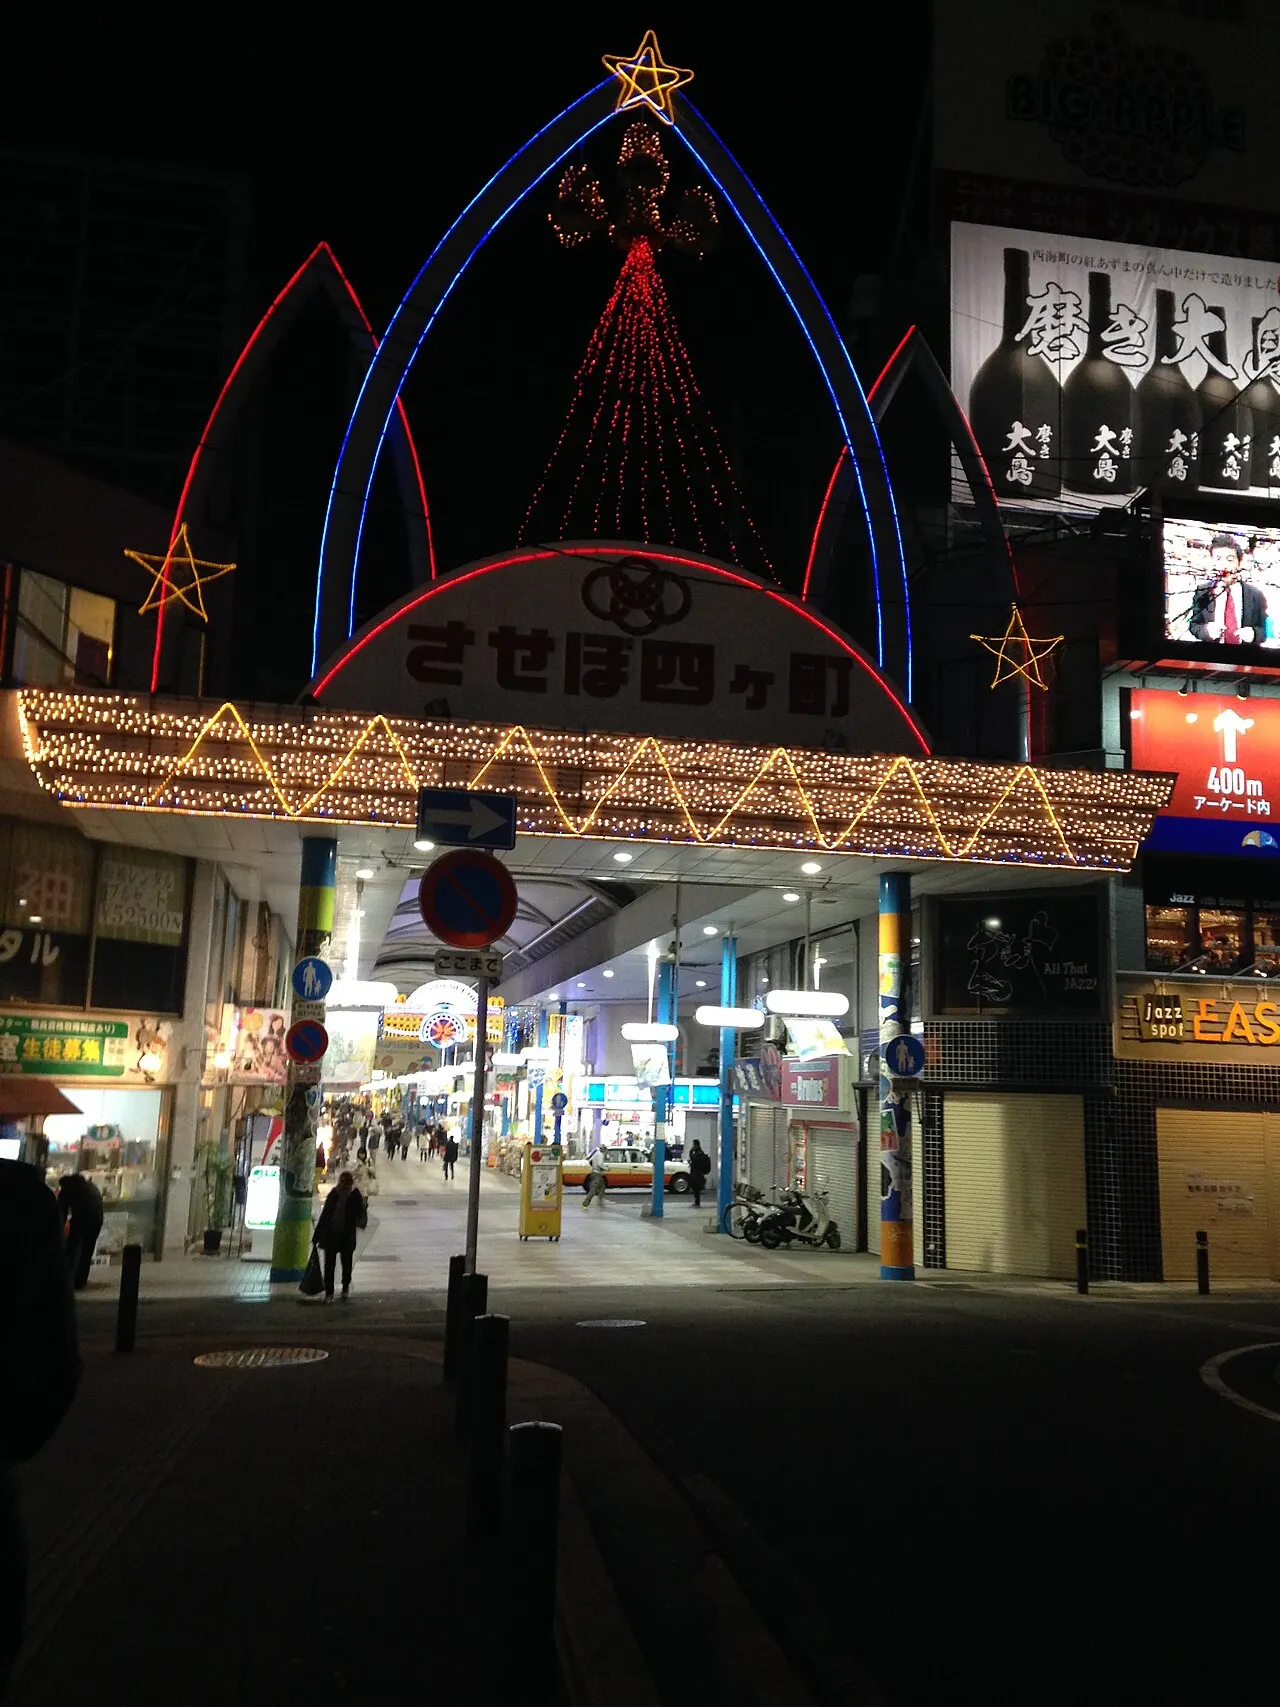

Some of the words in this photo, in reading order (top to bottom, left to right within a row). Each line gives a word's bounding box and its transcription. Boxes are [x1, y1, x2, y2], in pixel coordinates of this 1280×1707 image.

[1207, 766, 1263, 797] 400m
[1193, 794, 1271, 815] アーケード内
[438, 955, 498, 972] ここまで
[1044, 962, 1060, 975] All
[1063, 962, 1088, 975] That
[1146, 1003, 1182, 1021] jazz
[1151, 1022, 1184, 1038] spot
